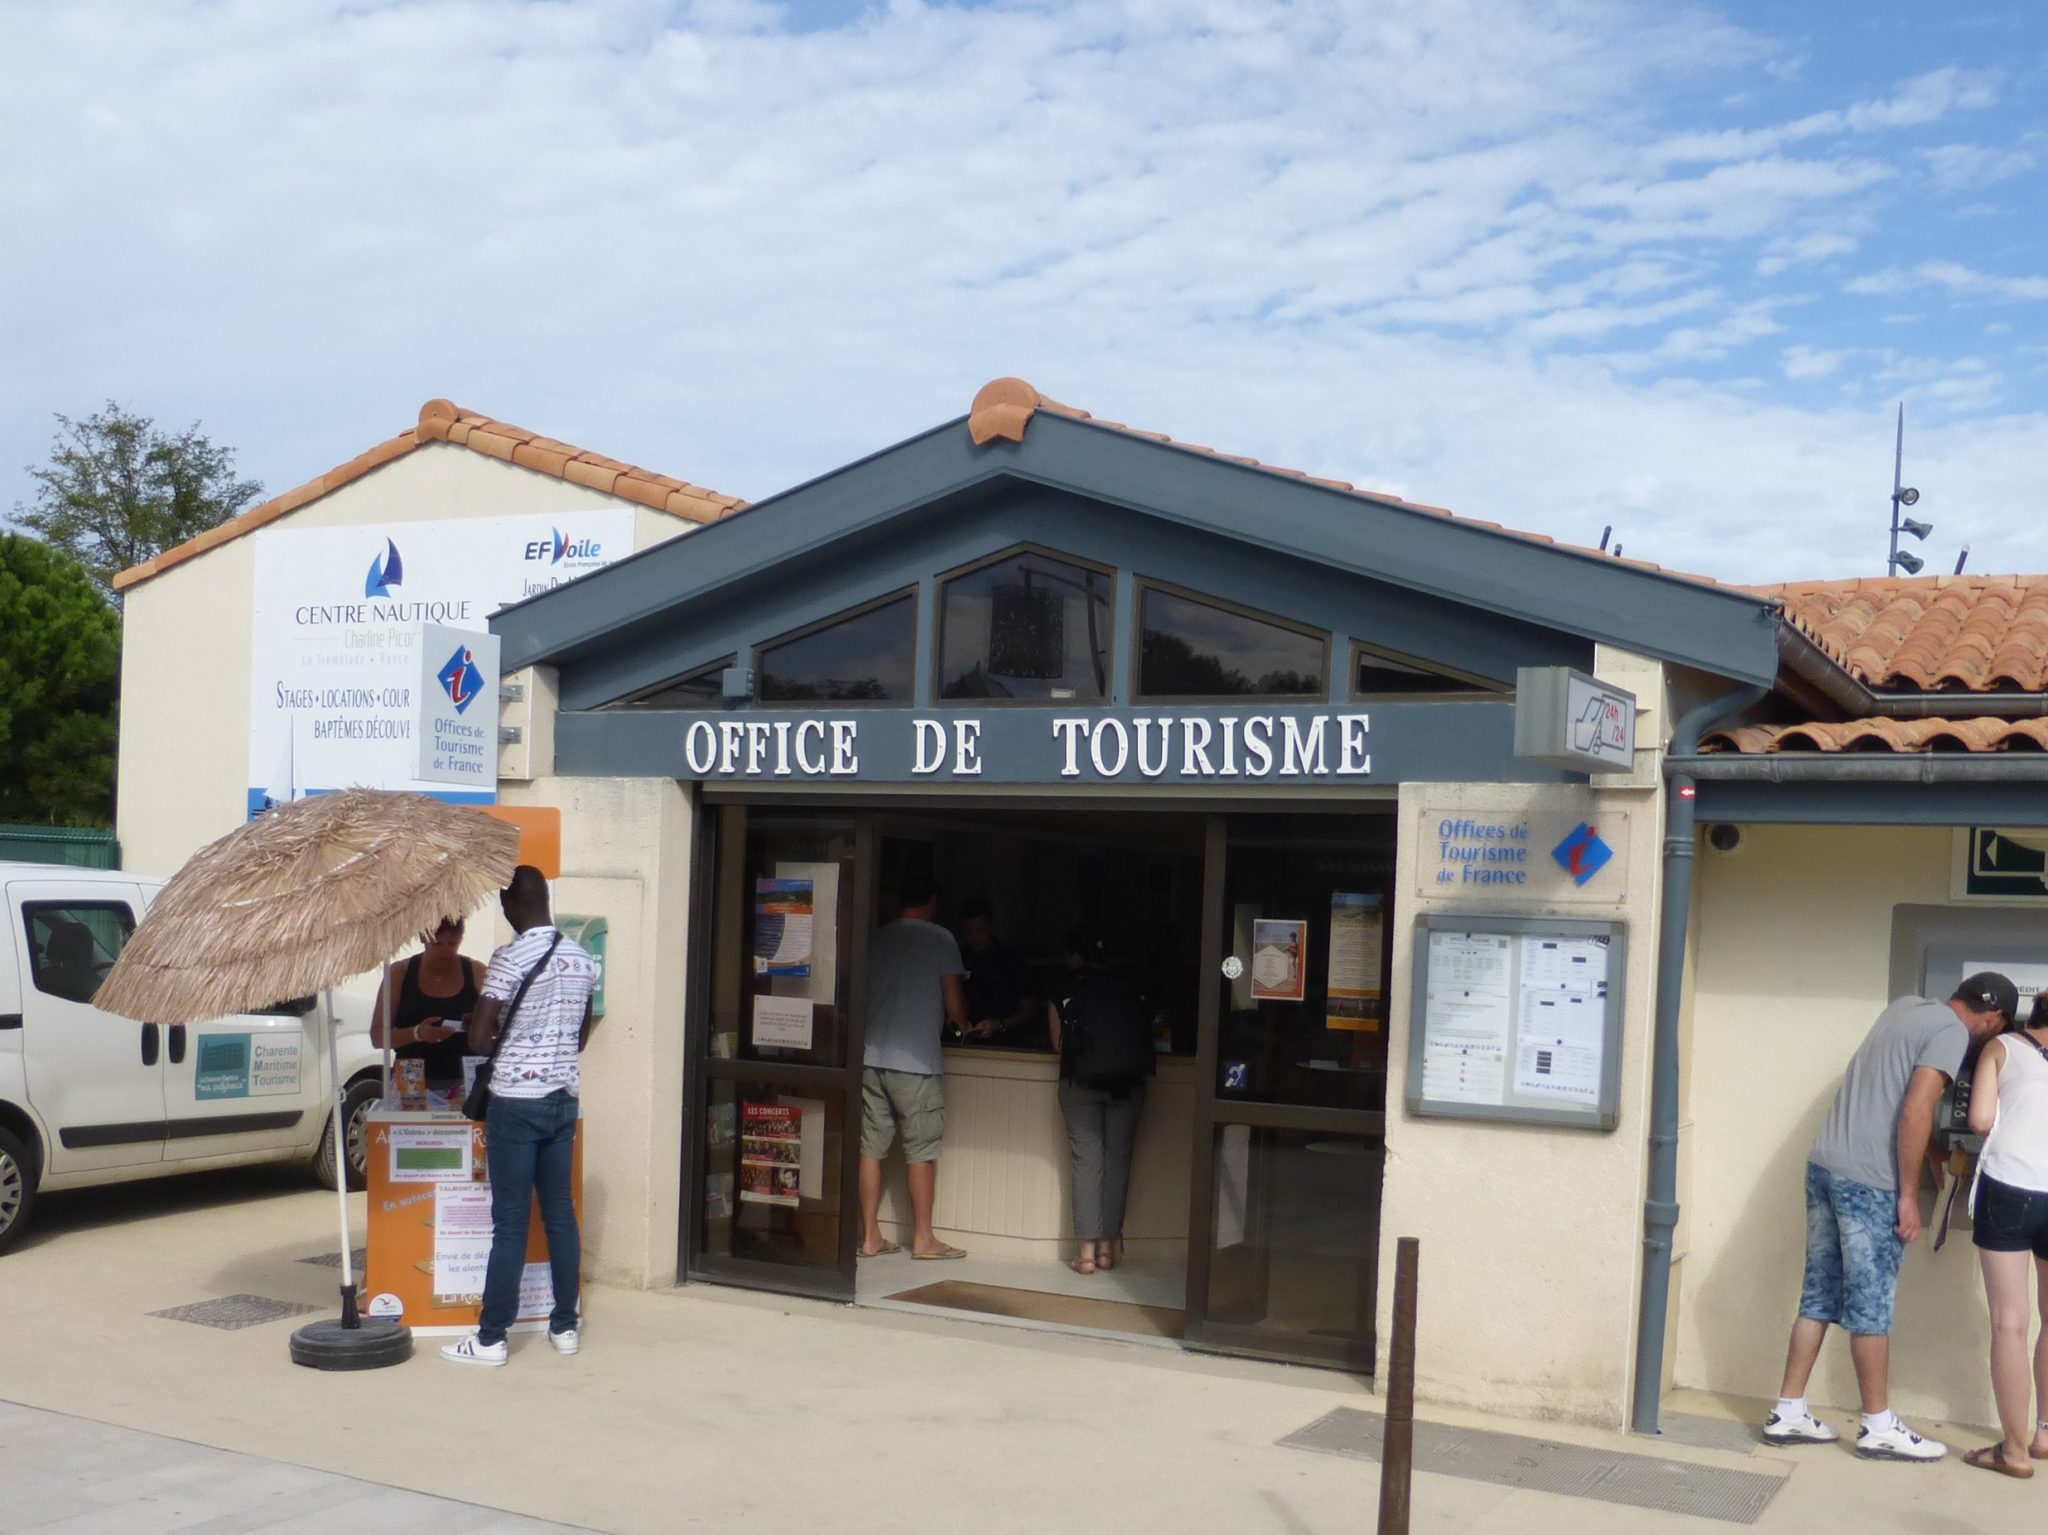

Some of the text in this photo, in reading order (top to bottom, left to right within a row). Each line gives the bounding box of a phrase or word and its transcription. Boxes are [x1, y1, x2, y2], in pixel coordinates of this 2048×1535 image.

[295, 600, 472, 625] CENTRE NAUTIQUE
[1605, 702, 1619, 723] 24h
[434, 718, 485, 738] Offices de
[434, 735, 485, 756] Tourisme
[685, 714, 1371, 777] OFFICE DE TOURISME
[433, 756, 484, 774] de France
[1439, 819, 1528, 841] Offices de
[1439, 841, 1527, 864] Tourisme
[1436, 864, 1527, 885] de France
[254, 1045, 299, 1057] Charente
[253, 1060, 298, 1072] Maritime
[253, 1074, 297, 1086] Tourisme
[759, 1107, 789, 1115] CONCERTS
